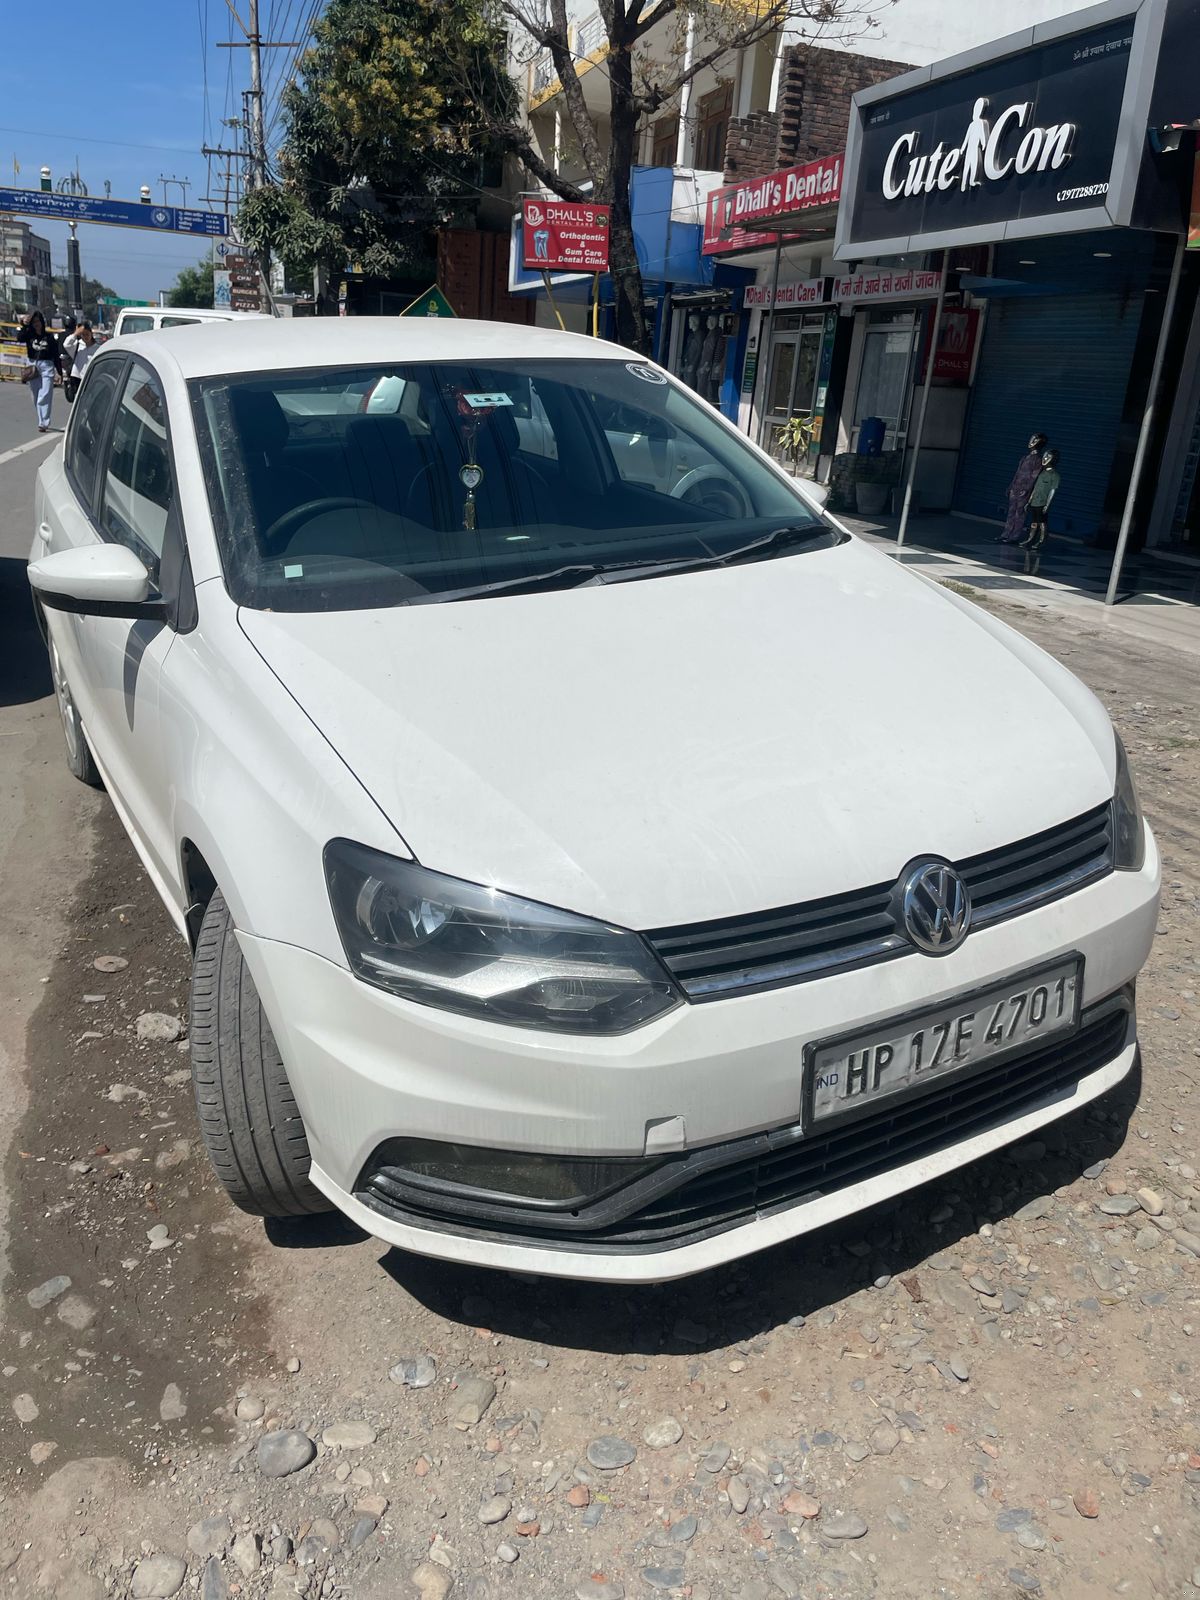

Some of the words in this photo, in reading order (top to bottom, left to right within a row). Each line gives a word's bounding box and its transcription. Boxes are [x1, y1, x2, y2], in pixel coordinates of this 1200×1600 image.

[882, 131, 960, 200] Cute
[984, 102, 1075, 180] Con
[735, 181, 782, 215] Dhall's
[785, 160, 840, 203] Dental
[1061, 183, 1109, 200] 7977288720
[547, 208, 594, 222] DHALL'S
[560, 231, 606, 242] Orthodontic
[558, 255, 583, 264] Dental
[585, 257, 607, 265] Clinic
[565, 248, 582, 256] Gum
[584, 249, 602, 257] Care
[748, 286, 771, 304] Dhall's
[775, 283, 796, 302] ental
[797, 283, 815, 302] Care
[853, 275, 864, 296] जी
[846, 1042, 894, 1096] HP
[983, 976, 1065, 1045] 4701
[816, 1073, 839, 1090] IND
